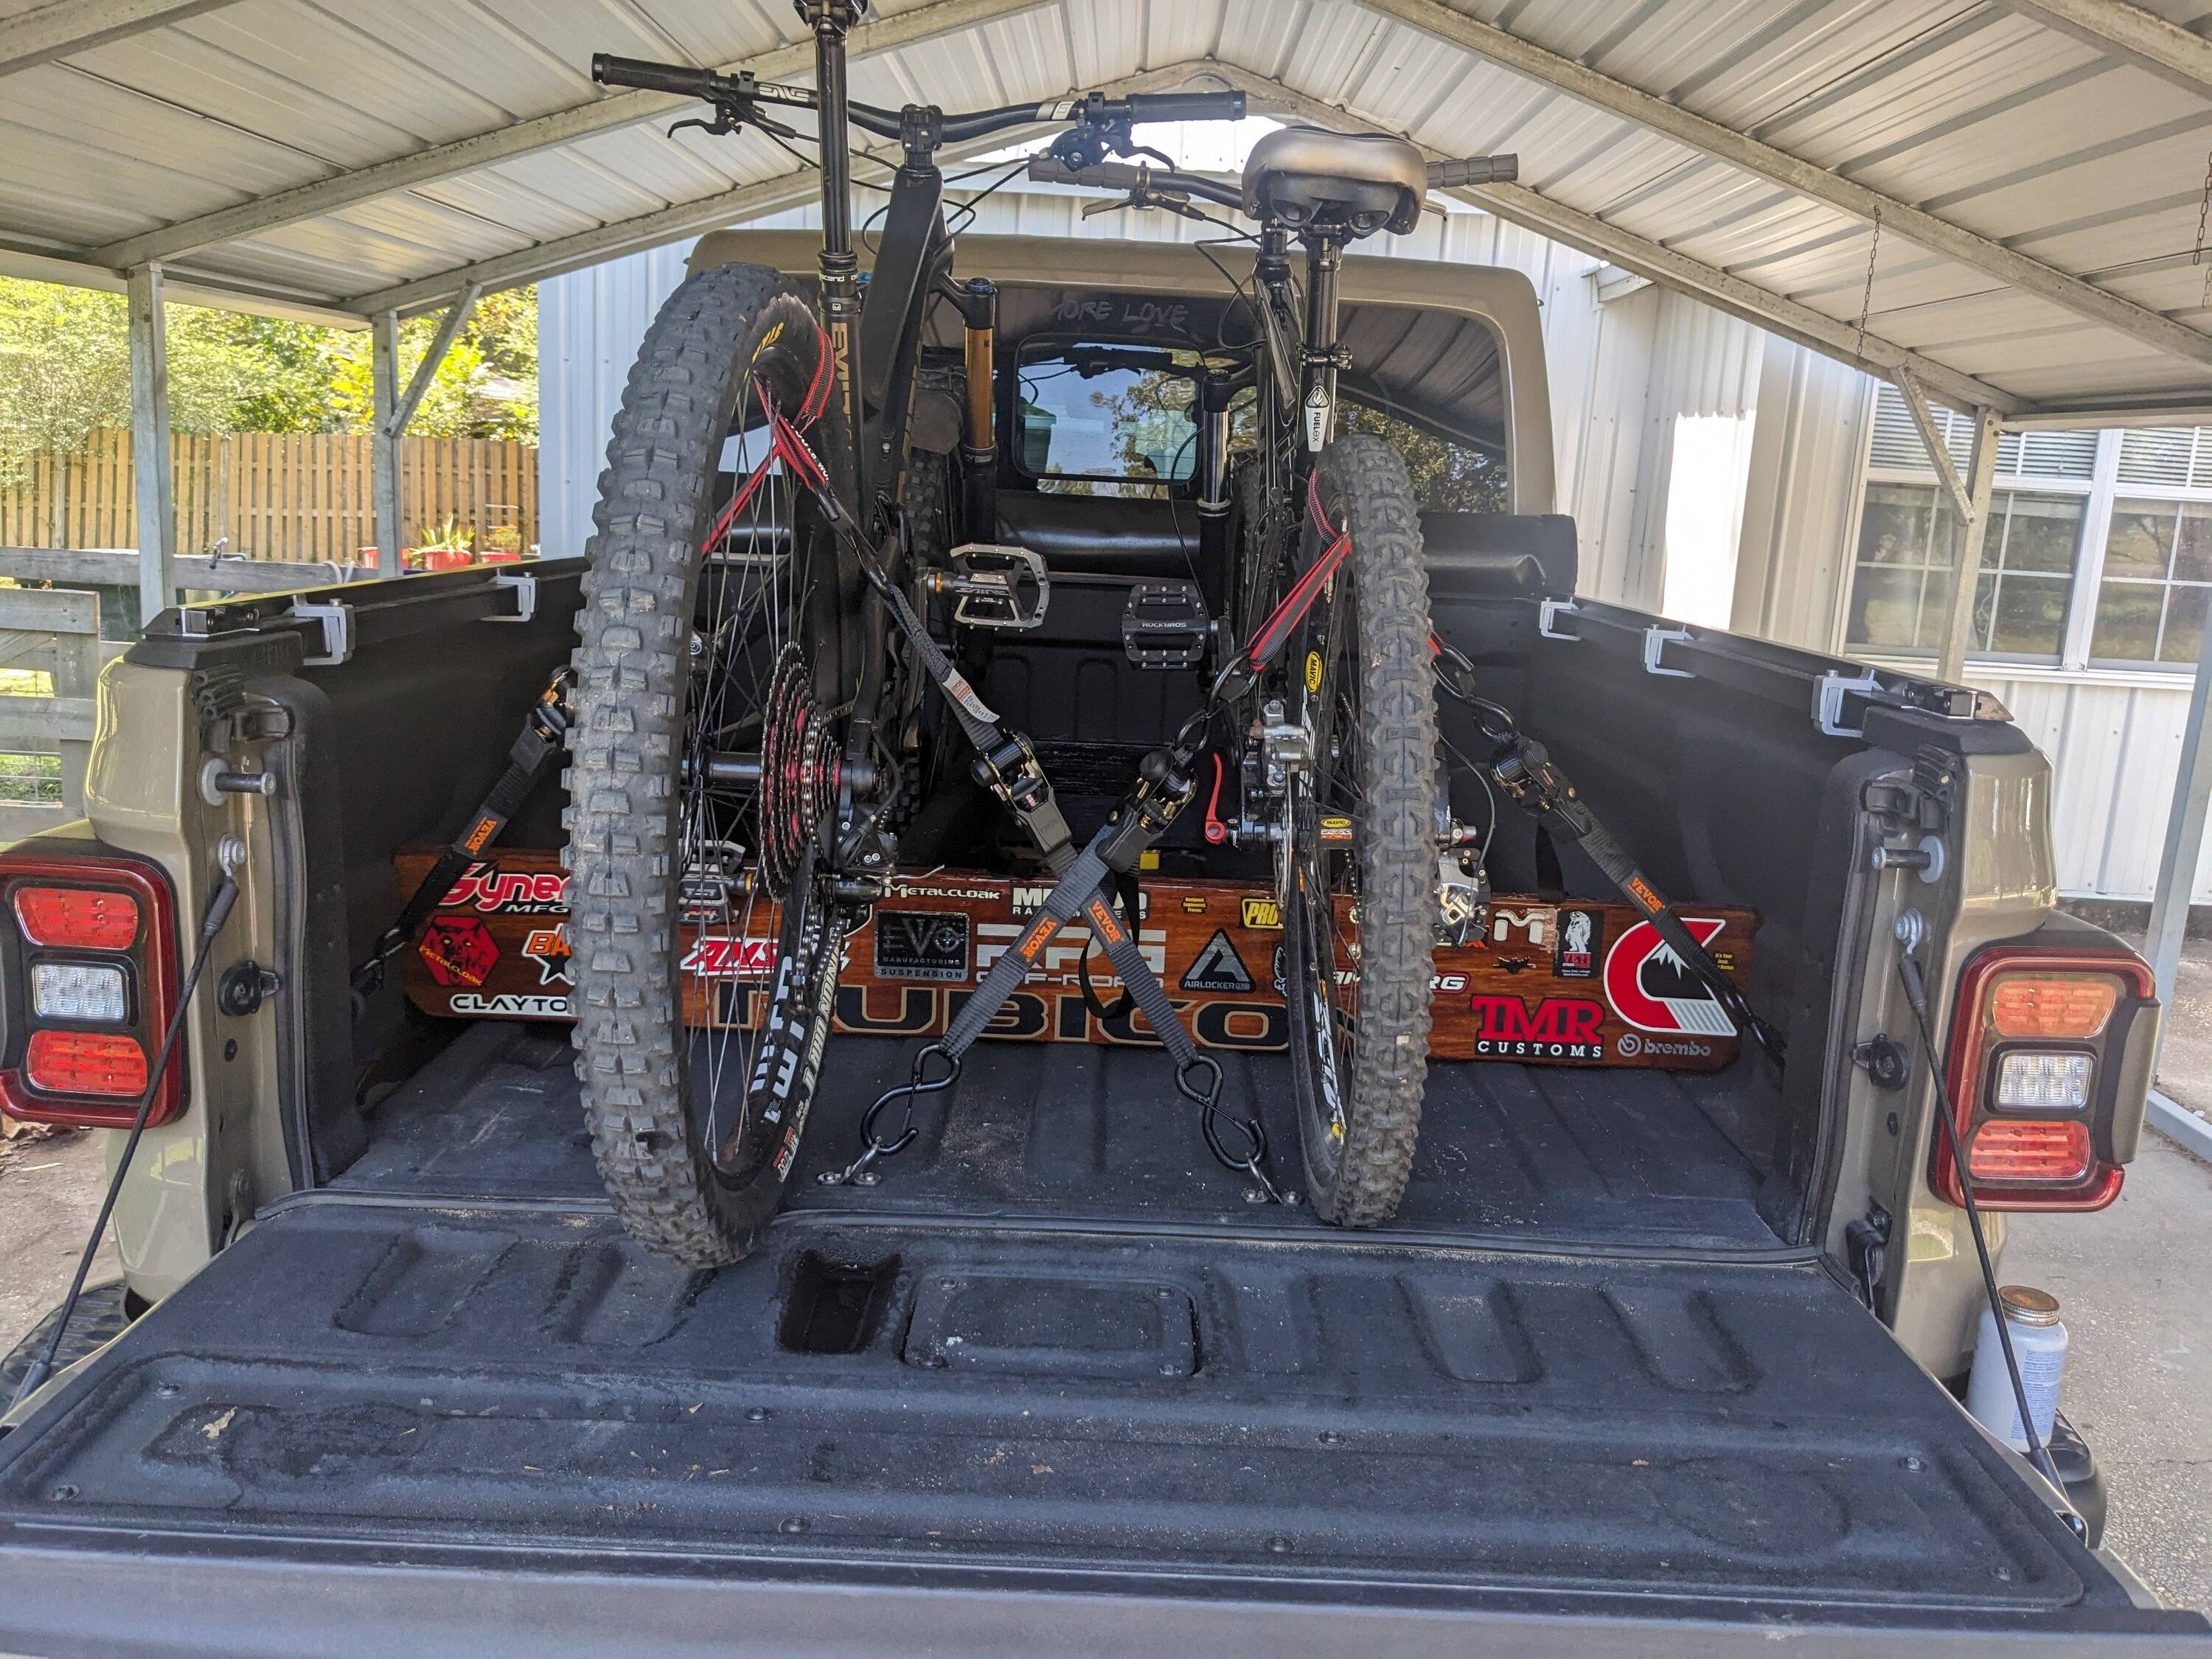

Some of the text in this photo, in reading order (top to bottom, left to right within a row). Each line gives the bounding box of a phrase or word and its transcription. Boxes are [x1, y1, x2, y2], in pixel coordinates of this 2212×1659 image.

[1121, 303, 1189, 333] LOVE
[1310, 658, 1319, 686] MAVIC
[468, 819, 498, 852] VEVOR
[1632, 877, 1663, 911] VEVOR
[506, 904, 569, 913] MFG
[1091, 900, 1121, 942] VEVOR
[1023, 920, 1057, 958] VEVOR
[881, 969, 963, 978] SUSPENSION
[1184, 981, 1235, 990] AIRLOCKER
[453, 996, 568, 1012] CLAYTO
[1472, 998, 1603, 1043] TMR
[1478, 1040, 1602, 1057] CUSTOMS
[1644, 1039, 1711, 1057] brembo
